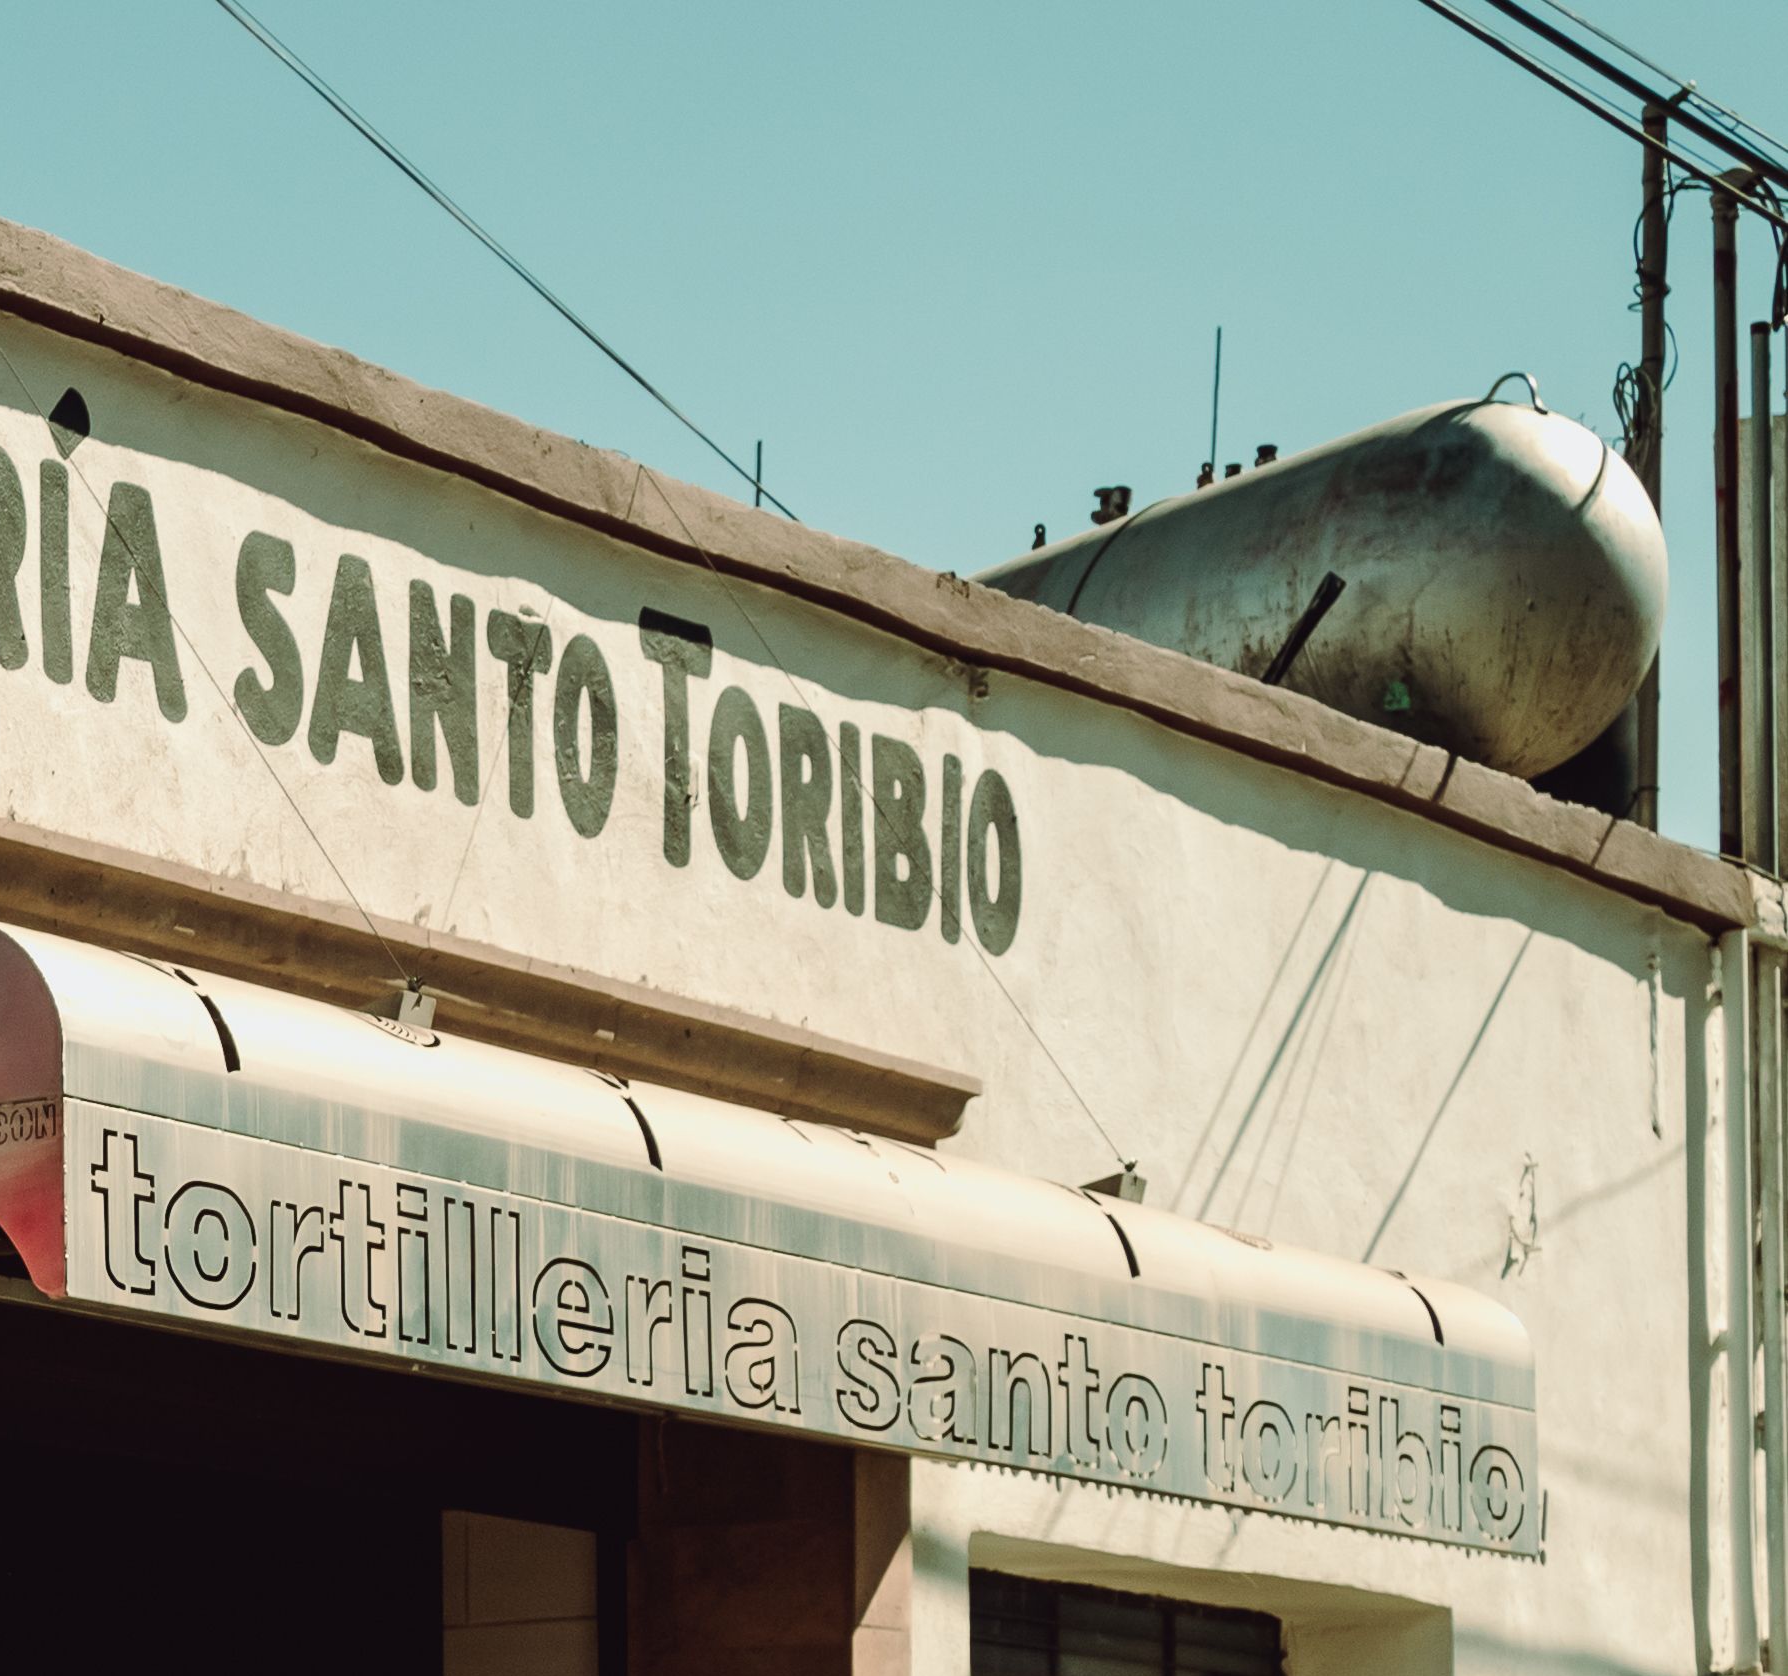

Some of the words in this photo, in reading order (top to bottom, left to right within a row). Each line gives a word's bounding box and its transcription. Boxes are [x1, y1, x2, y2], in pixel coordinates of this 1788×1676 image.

[234, 530, 619, 840] SANTO
[638, 606, 1023, 958] TORIBIO
[90, 1129, 801, 1416] tortilleria
[835, 1319, 1169, 1479] santo
[1196, 1362, 1526, 1542] toribio
